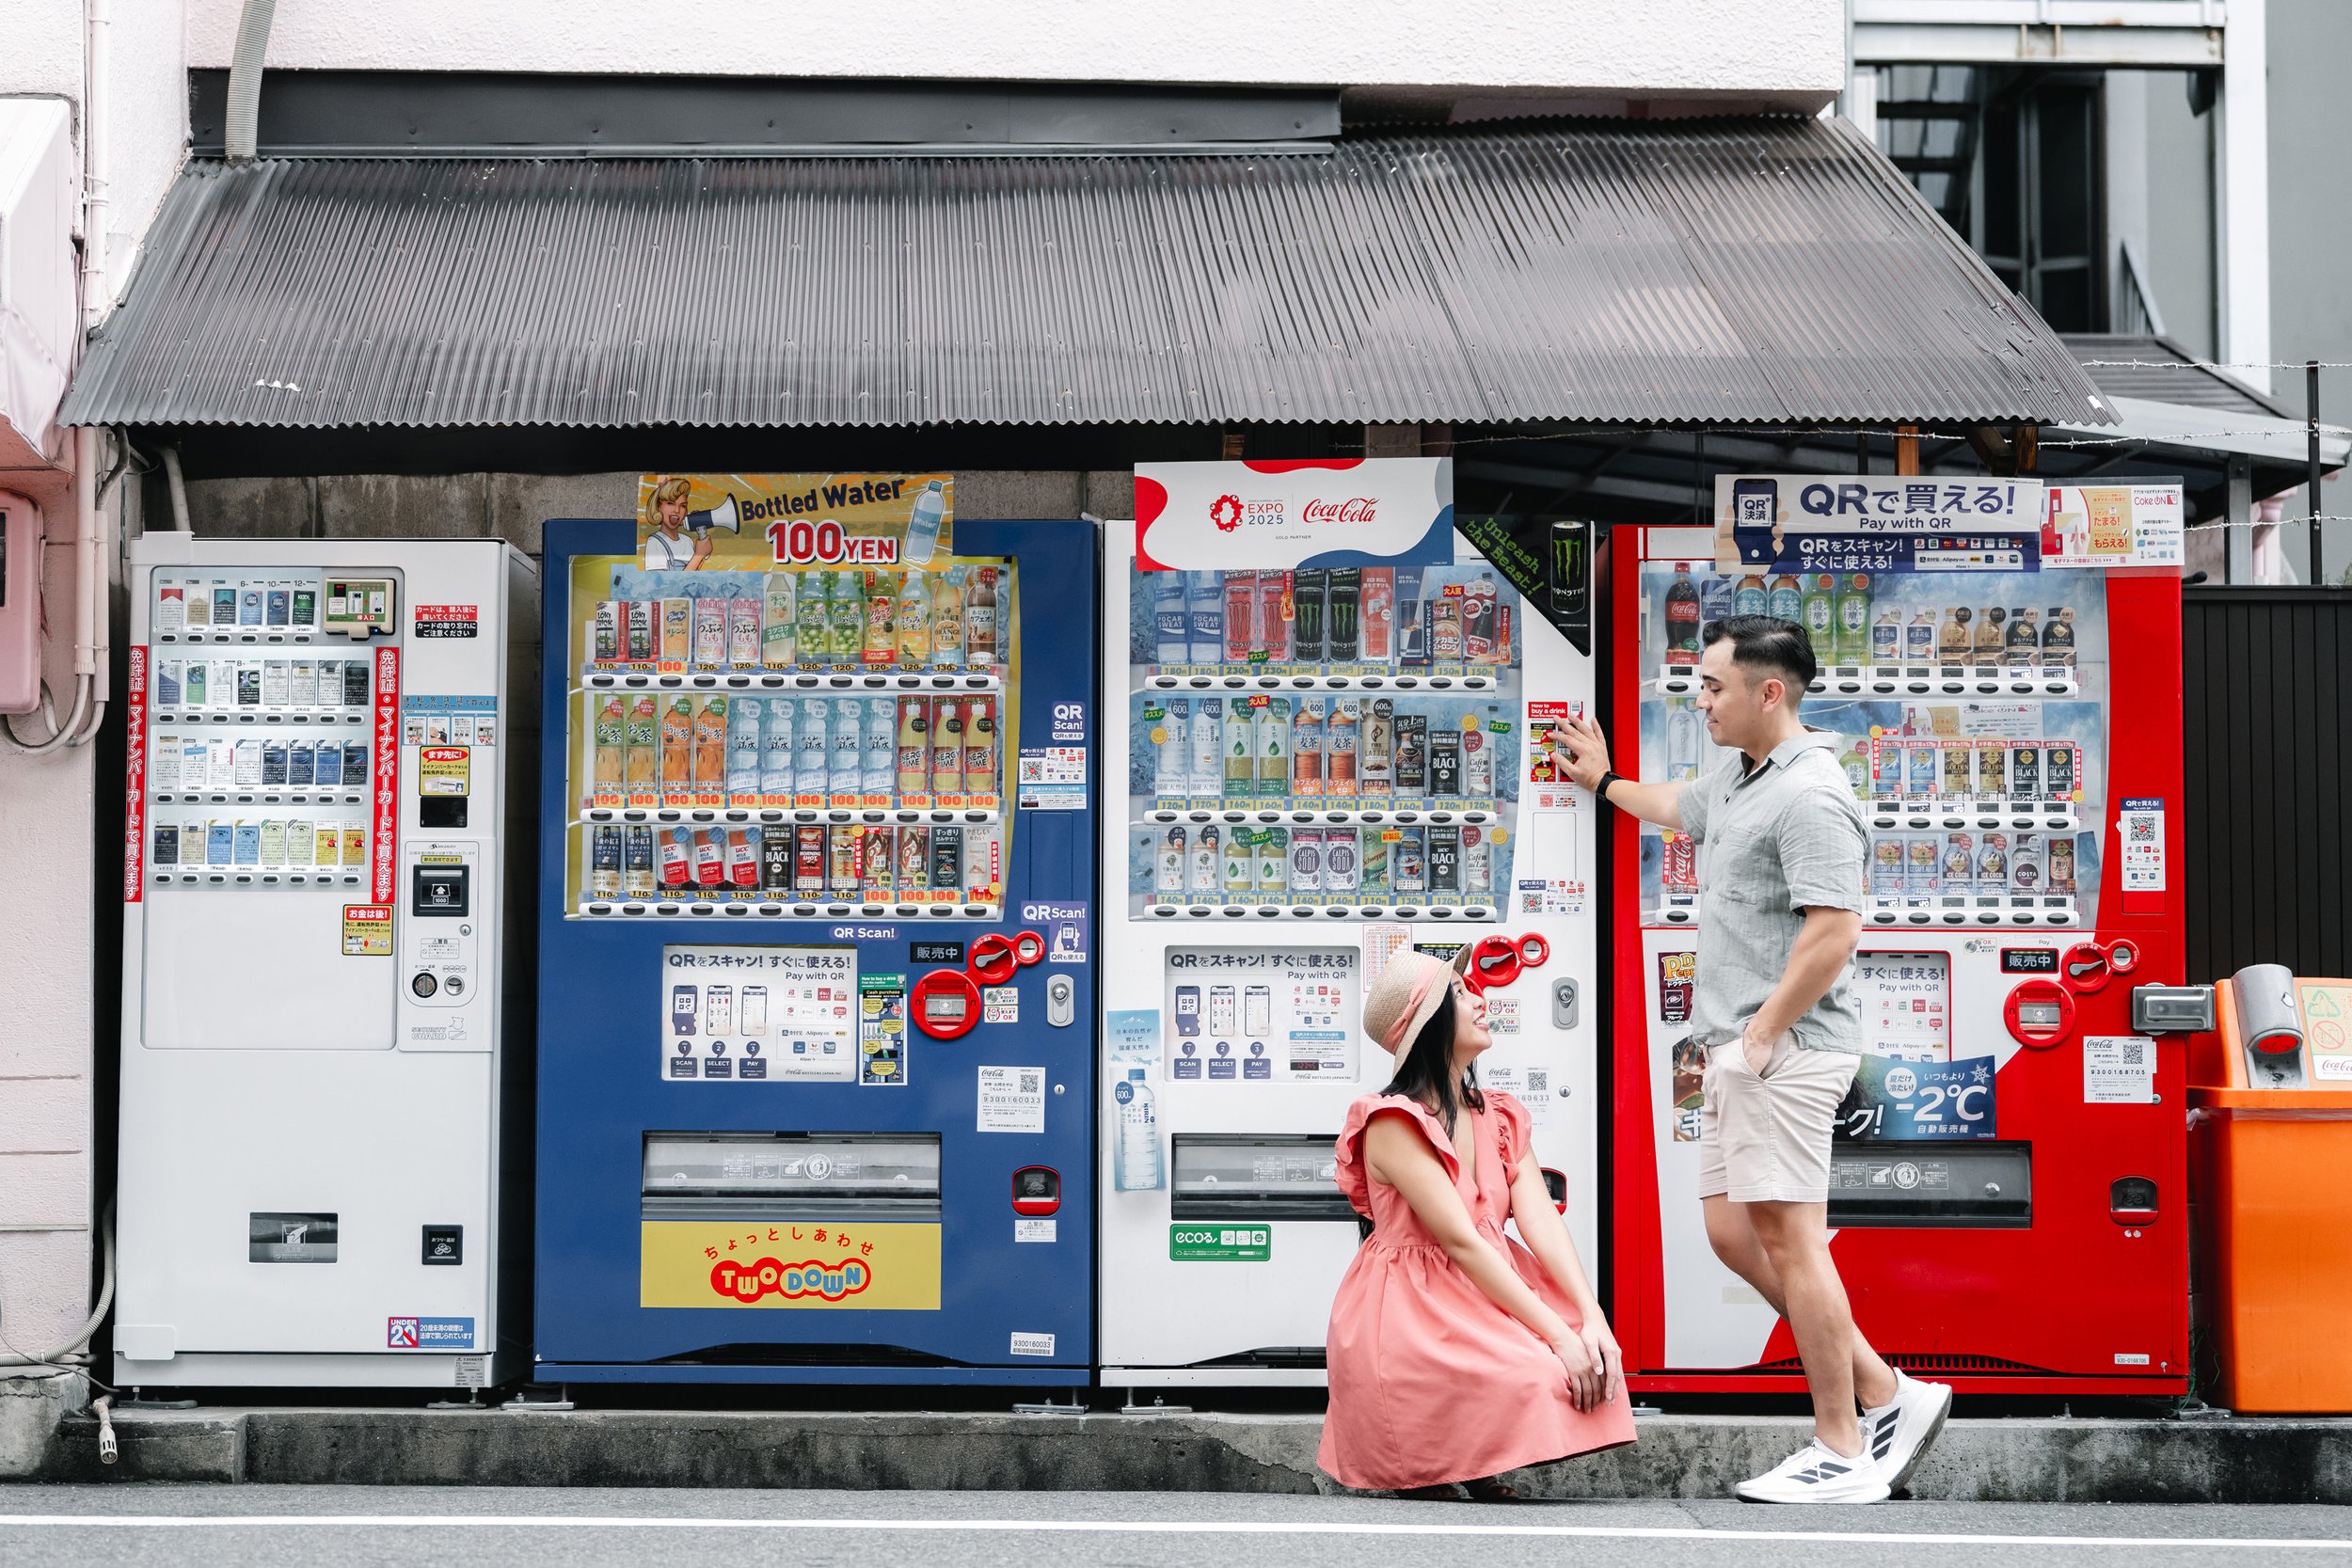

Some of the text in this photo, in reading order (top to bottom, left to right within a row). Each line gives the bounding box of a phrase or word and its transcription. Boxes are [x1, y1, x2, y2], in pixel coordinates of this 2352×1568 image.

[741, 478, 905, 521] Bottled Water
[1744, 499, 1766, 511] QR
[1800, 483, 2015, 516] QRで買える!
[2135, 497, 2153, 505] Coke
[1248, 504, 1284, 514] EXPO
[1302, 498, 1381, 523] Coca-Cola
[1248, 515, 1284, 525] 2025
[1744, 510, 1767, 521] 決済
[914, 518, 937, 530] Water
[1860, 517, 1951, 531] Pay with QR
[2094, 517, 2120, 526] たまる!
[767, 521, 896, 562] 100 YEN
[1484, 517, 1541, 574] Unleash
[1799, 538, 1903, 553] QRをスキャン!
[2094, 539, 2127, 548] もらえる!
[1465, 520, 1545, 595] the Beast!
[1800, 555, 1893, 570] すぐに使える!
[1702, 594, 1732, 604] AQUARIUS
[1054, 705, 1083, 720] QR
[1055, 721, 1083, 730] Scan!
[903, 760, 920, 768] TIME
[937, 760, 954, 768] TIME
[1433, 758, 1456, 768] BLACK
[2049, 768, 2072, 777] BLACK
[935, 828, 959, 836] すっきり
[765, 852, 788, 863] BLACK
[1432, 853, 1455, 863] BLACK
[1298, 857, 1316, 870] SODA
[1333, 857, 1350, 870] SODA
[349, 910, 388, 919] お金は後!
[1023, 906, 1086, 920] QR Scan!
[834, 927, 895, 938] QR Scan!
[917, 947, 958, 958] 販売中
[670, 954, 850, 968] QRをスキャン! すぐに使える!
[1170, 955, 1353, 968] QRをスキャン! すぐに使える!
[2009, 956, 2051, 968] 販売中
[786, 972, 845, 981] Pay with QR
[1288, 972, 1305, 980] Pay
[1863, 967, 1946, 980] すぐに使える!
[1879, 984, 1897, 992] Pay
[1889, 1084, 1914, 1092] 冷たい!
[1917, 1125, 1968, 1133] 自動販売機
[704, 1227, 874, 1259] ちょっとしあわせ
[722, 1267, 860, 1294] TWO DOWN
[390, 1325, 416, 1345] 20
